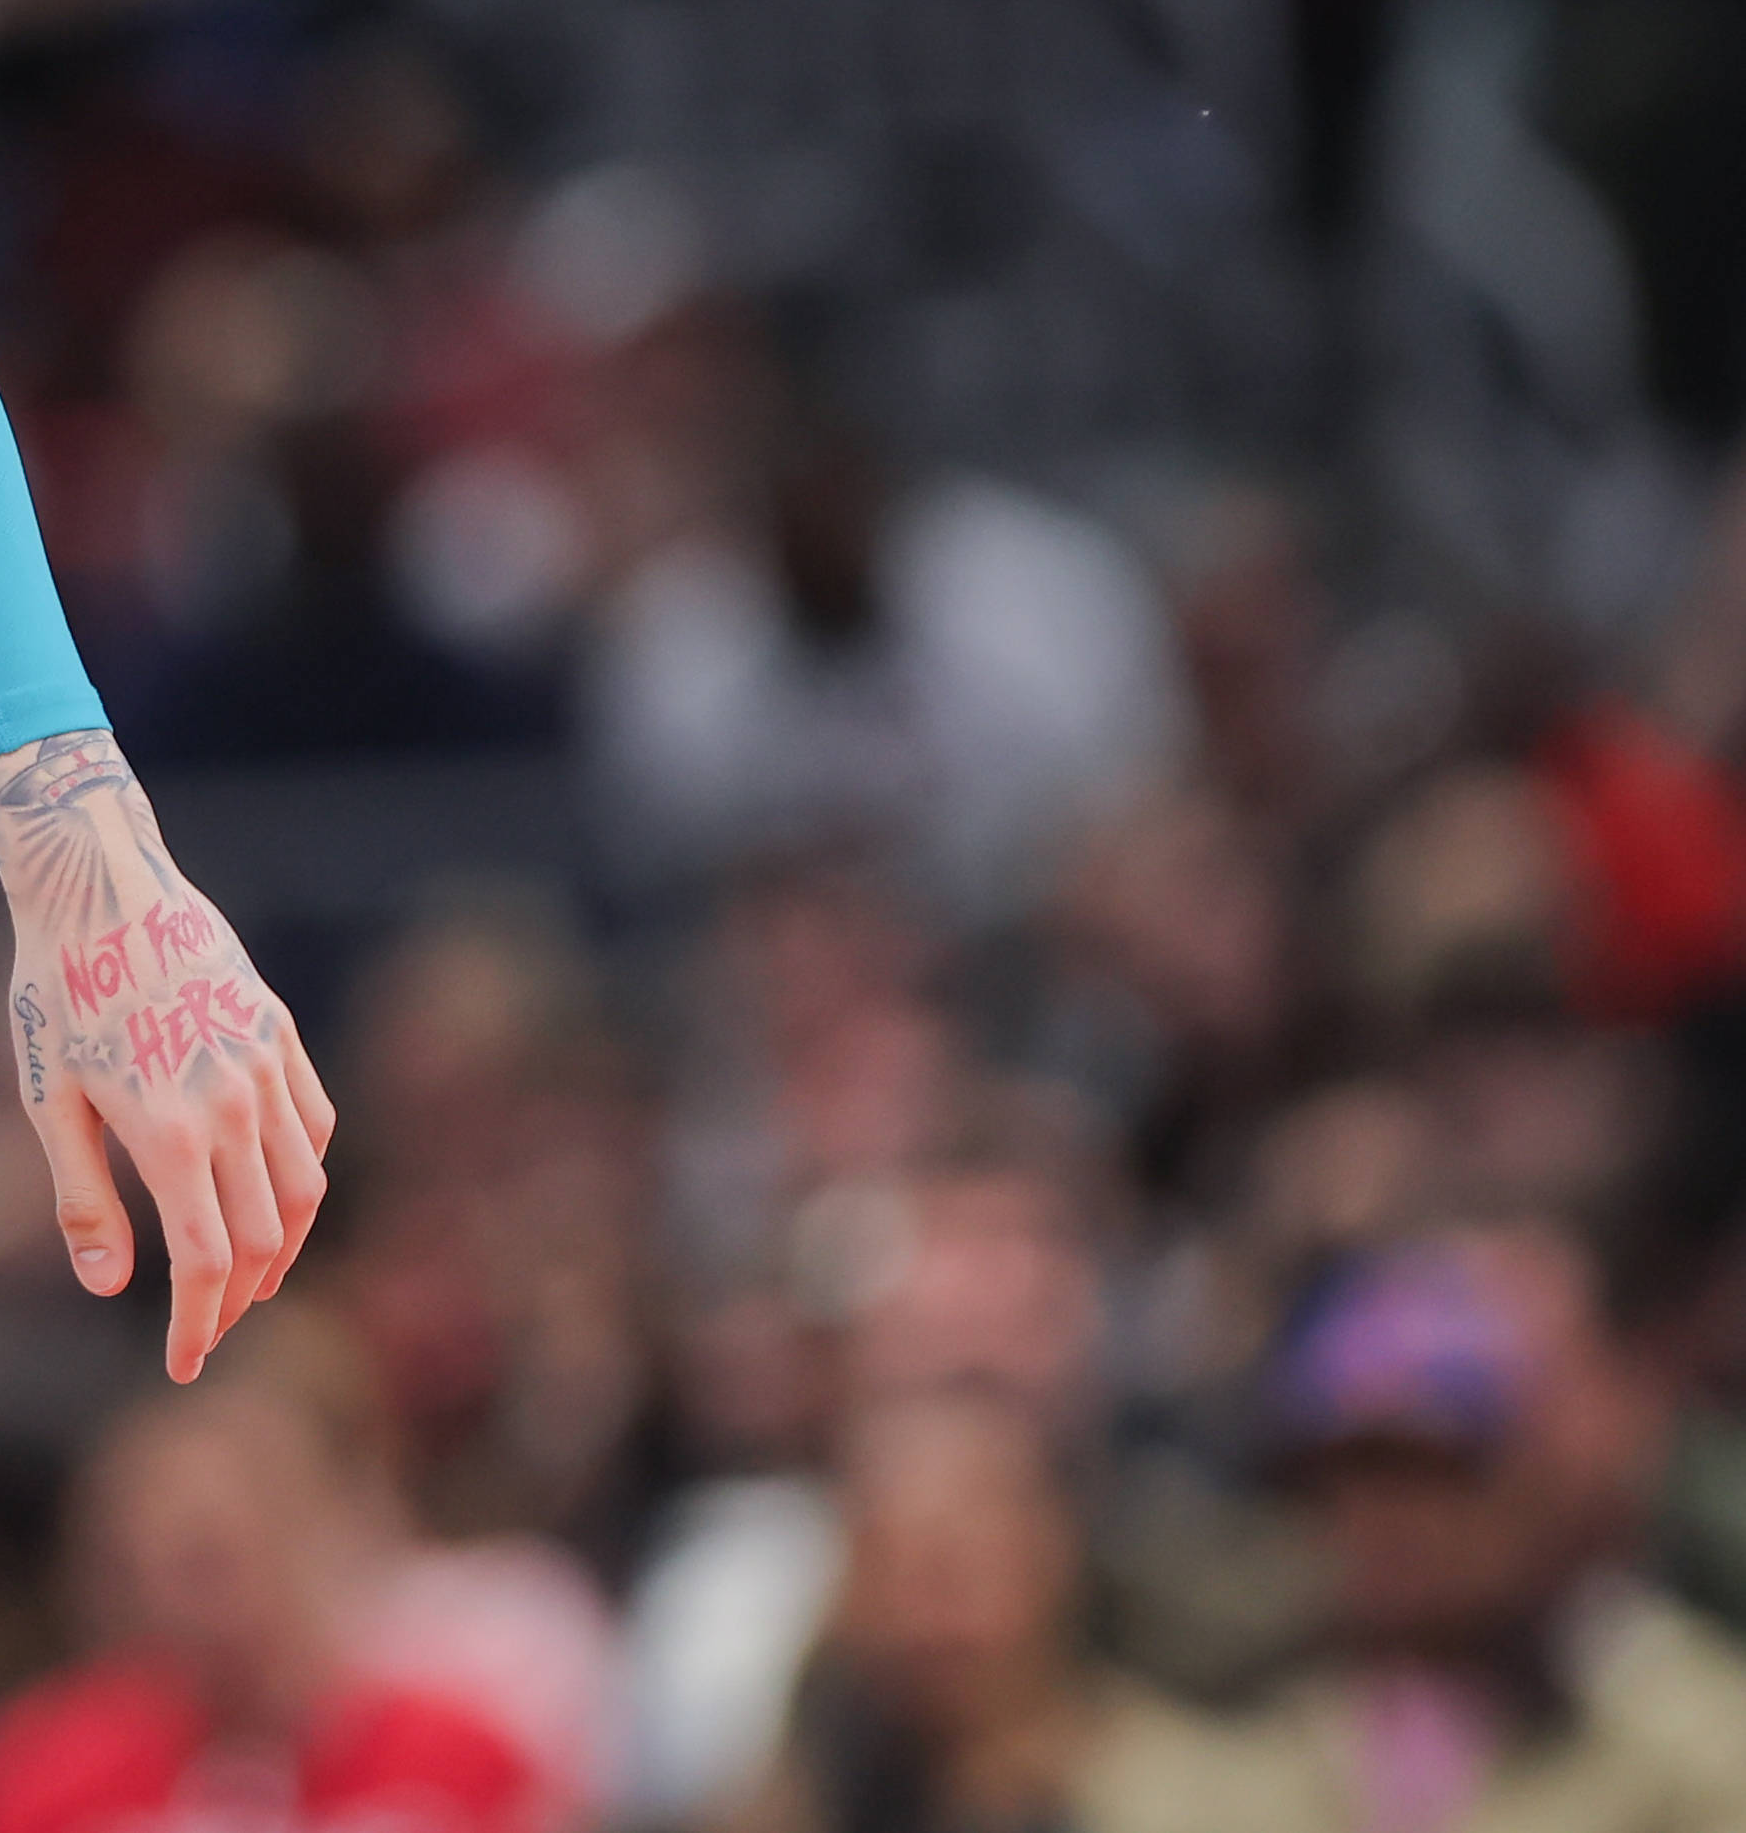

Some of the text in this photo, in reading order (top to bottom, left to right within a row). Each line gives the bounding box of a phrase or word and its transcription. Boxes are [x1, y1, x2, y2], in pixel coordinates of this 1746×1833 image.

[61, 891, 217, 1021] NOT FROM
[13, 982, 47, 1105] Golden
[125, 979, 261, 1087] HERE
